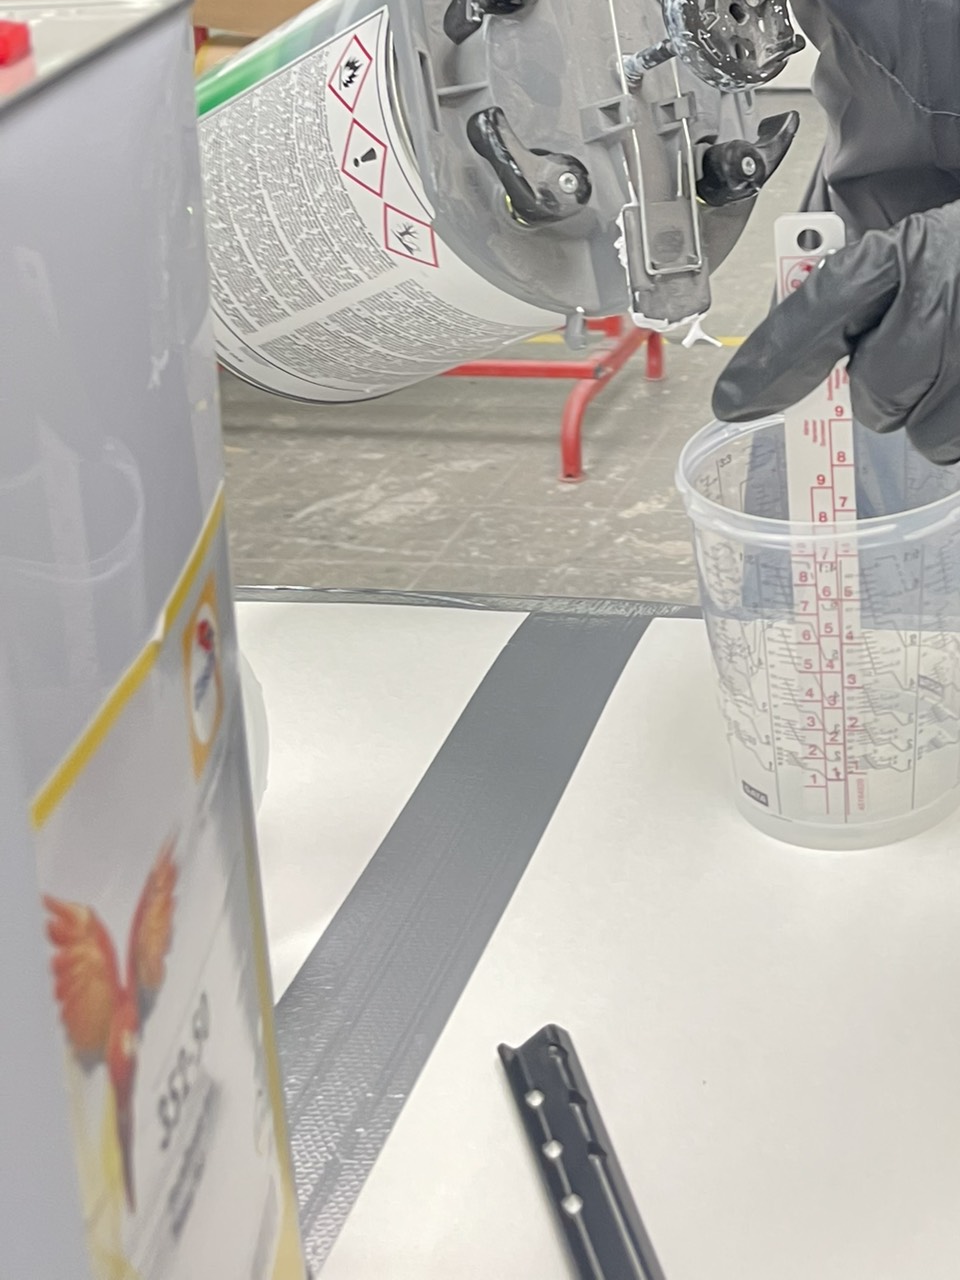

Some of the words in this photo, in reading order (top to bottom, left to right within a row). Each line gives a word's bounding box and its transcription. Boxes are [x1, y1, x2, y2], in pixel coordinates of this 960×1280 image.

[835, 405, 844, 417] 9
[837, 451, 846, 463] 8
[816, 474, 826, 486] 9
[839, 497, 848, 507] 7
[818, 511, 828, 523] 8
[799, 571, 808, 582] 8
[822, 586, 832, 597] 6
[801, 600, 809, 611] 7
[824, 623, 834, 634] 5
[802, 630, 811, 641] 6
[804, 659, 813, 670] 5
[826, 660, 835, 669] 4
[847, 674, 857, 685] 3
[805, 688, 814, 698] 4
[806, 716, 816, 727] 3
[847, 716, 858, 728] 2
[808, 745, 817, 756] 2
[809, 773, 817, 784] 1
